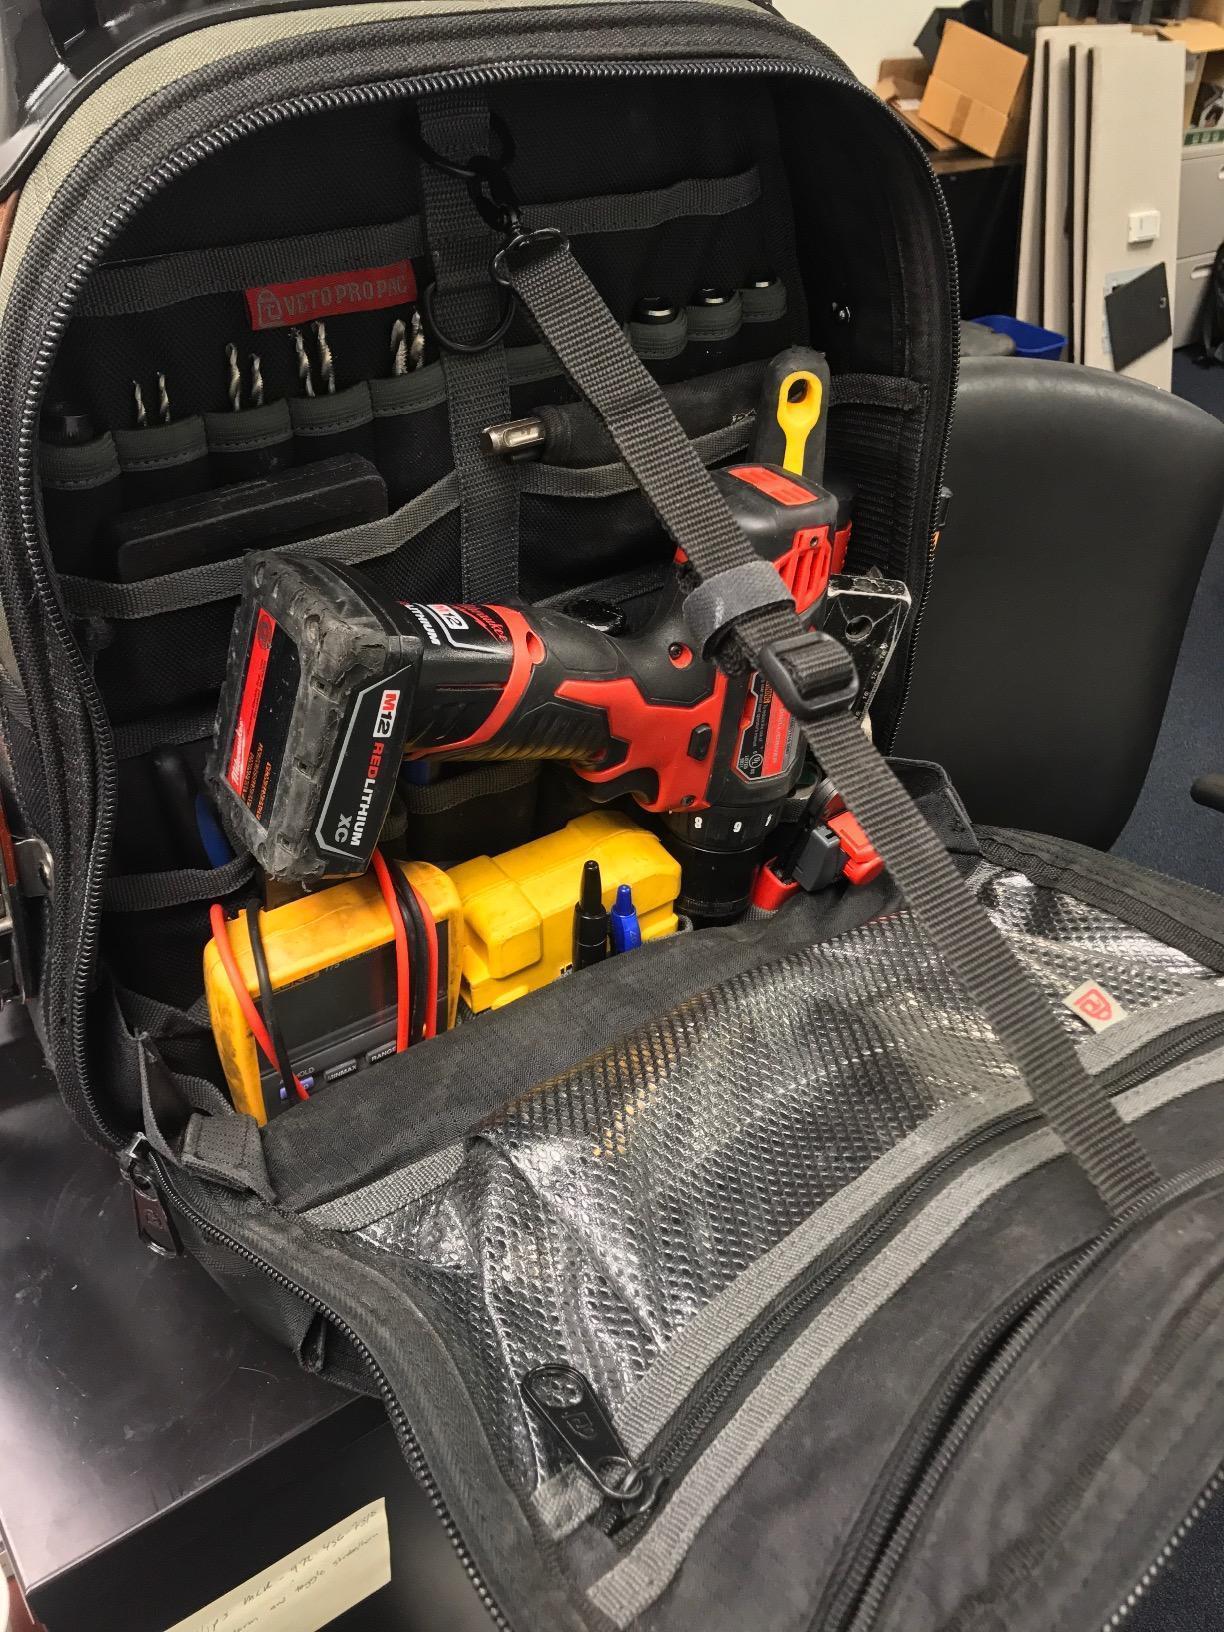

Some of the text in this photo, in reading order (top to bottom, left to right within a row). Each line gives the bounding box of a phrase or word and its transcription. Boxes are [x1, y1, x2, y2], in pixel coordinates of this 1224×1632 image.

[283, 274, 409, 316] VETO PRO PAC
[433, 603, 465, 628] M12
[350, 692, 397, 847] M12 REDLITHIUM
[334, 813, 353, 843] XC
[327, 1063, 358, 1081] MINMAX
